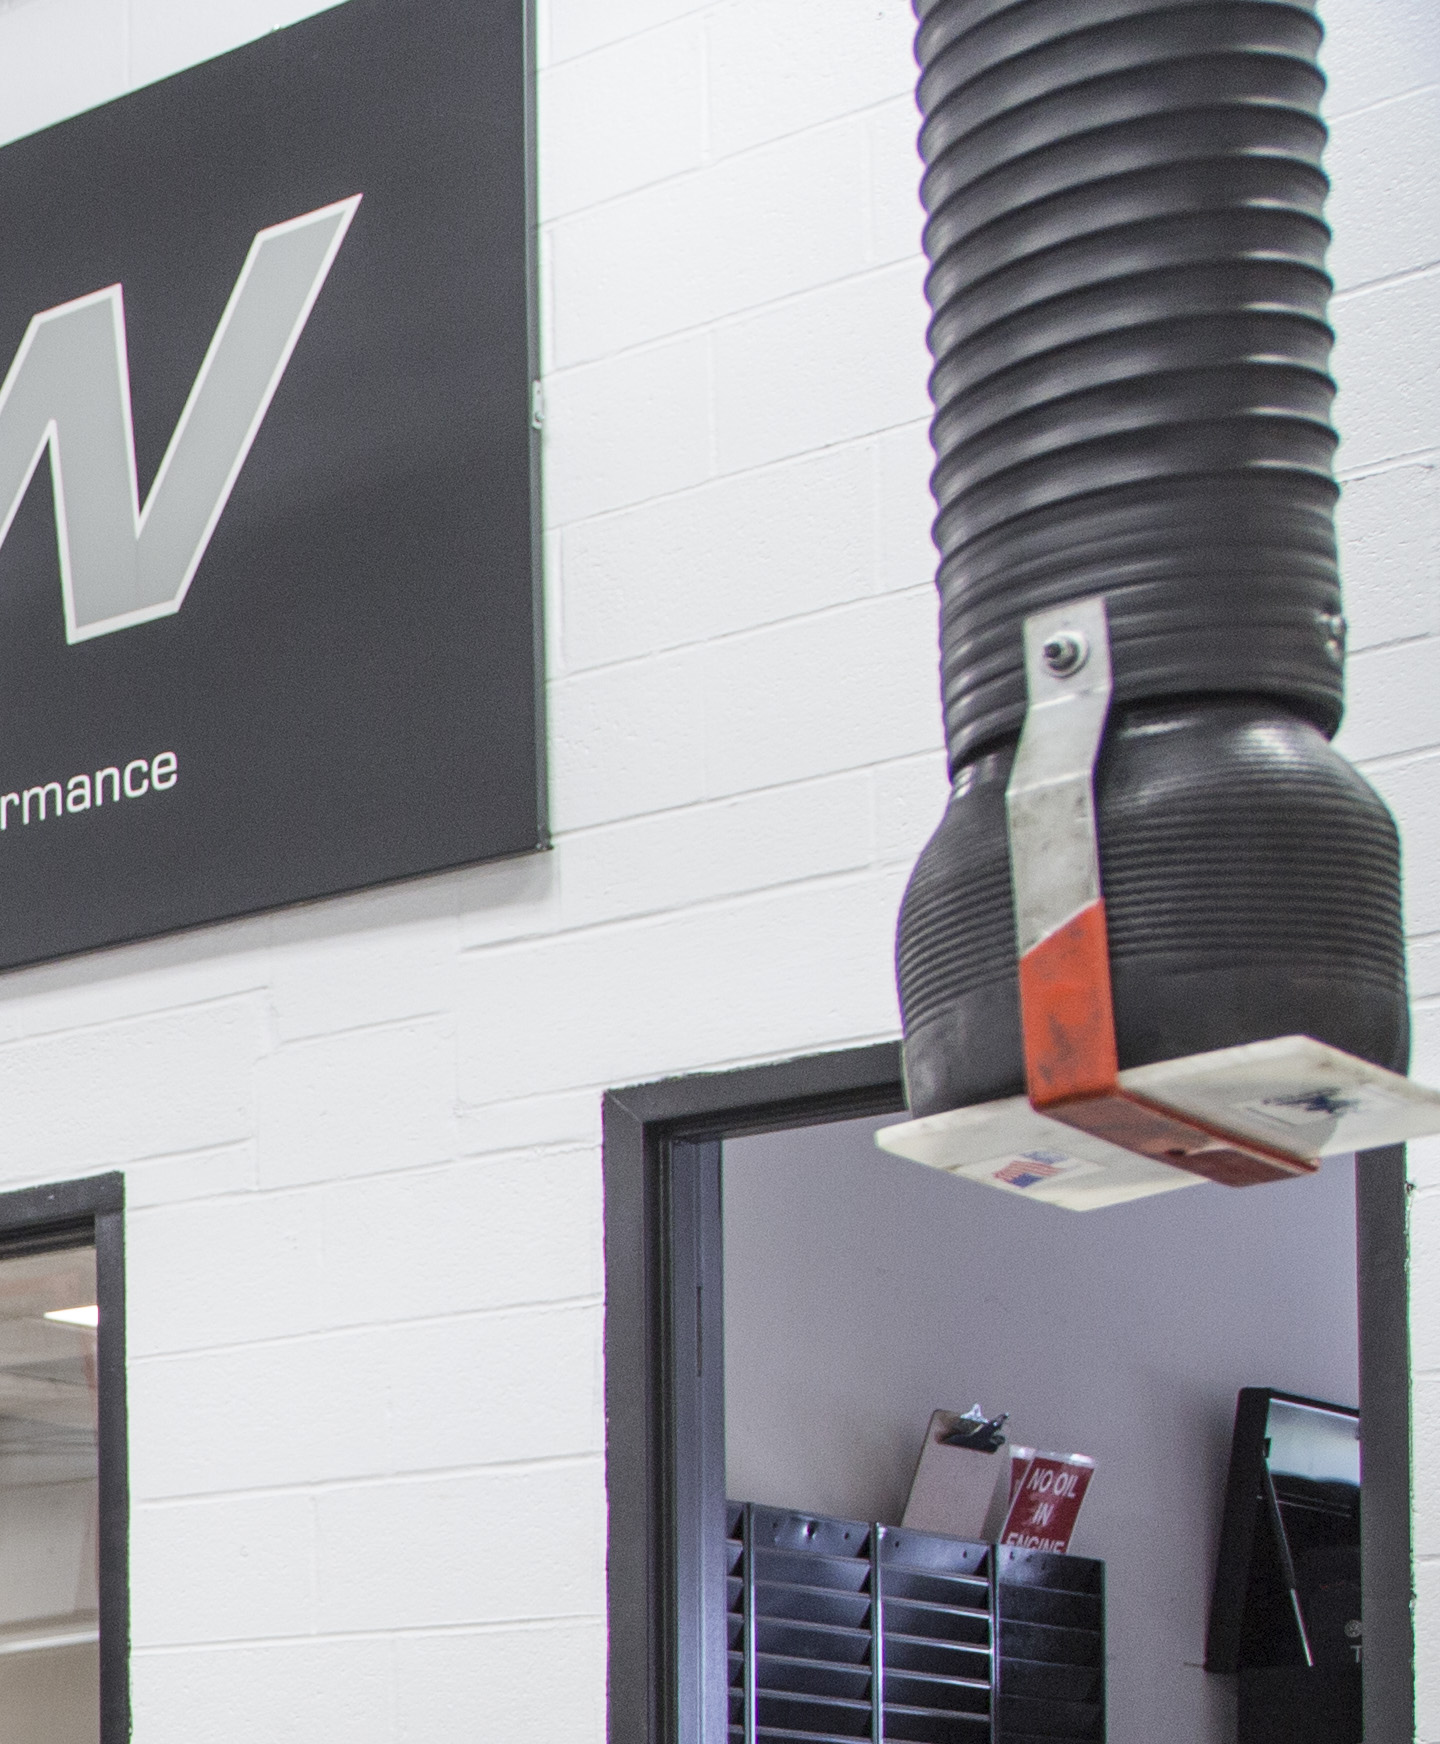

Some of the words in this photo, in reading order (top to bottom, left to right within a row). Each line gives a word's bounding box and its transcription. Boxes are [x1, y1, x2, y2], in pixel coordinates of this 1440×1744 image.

[1026, 1467, 1054, 1493] NO
[1053, 1471, 1079, 1499] OIL
[1032, 1502, 1055, 1527] IN
